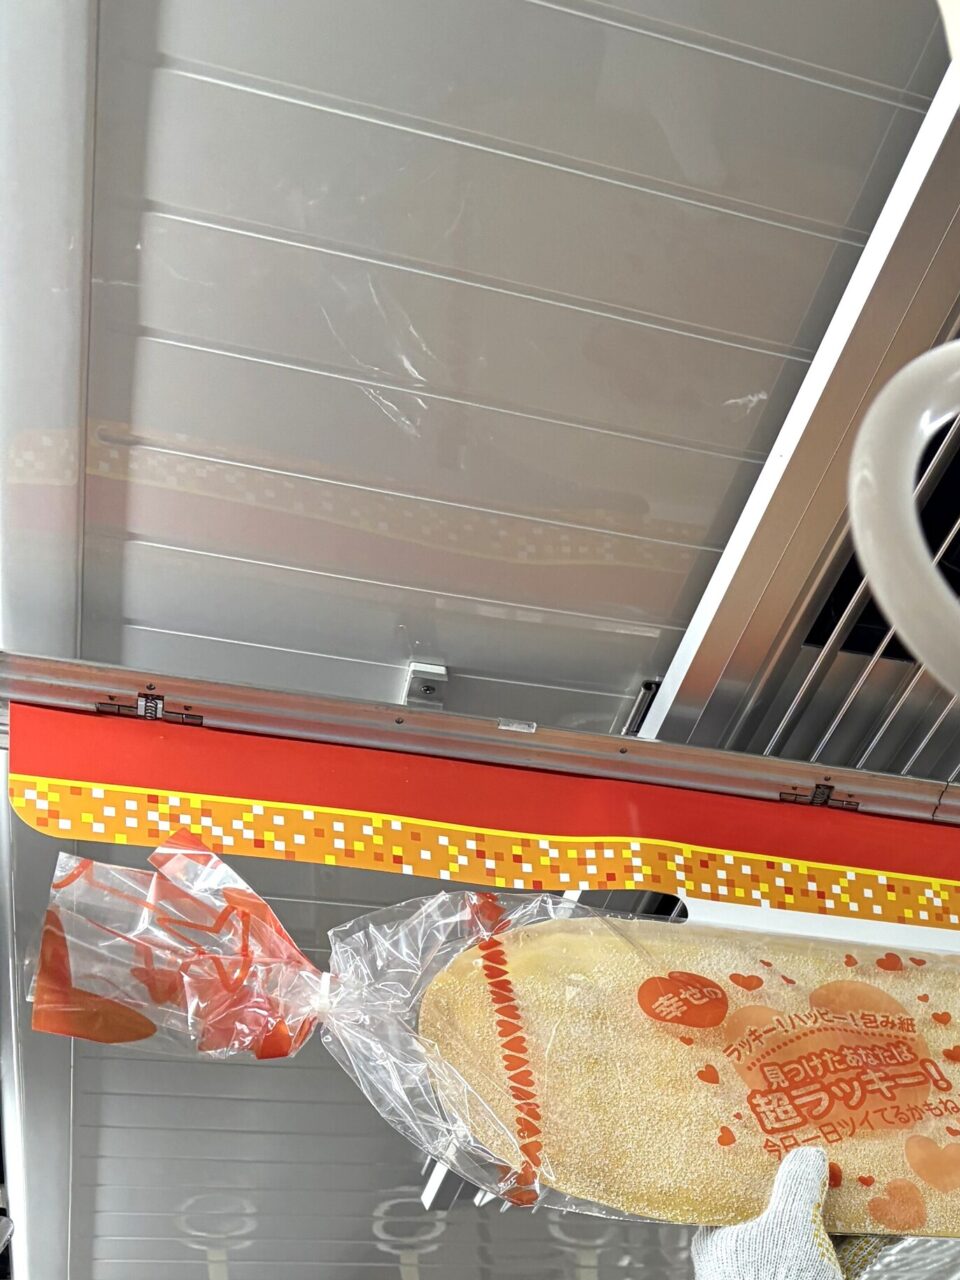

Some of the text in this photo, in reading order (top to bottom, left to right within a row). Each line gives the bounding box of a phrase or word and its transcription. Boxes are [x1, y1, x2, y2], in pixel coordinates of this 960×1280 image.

[651, 985, 722, 1019] 幸せの
[762, 1042, 915, 1089] 見つけたあなたは
[749, 1060, 951, 1132] 超ラッキー!
